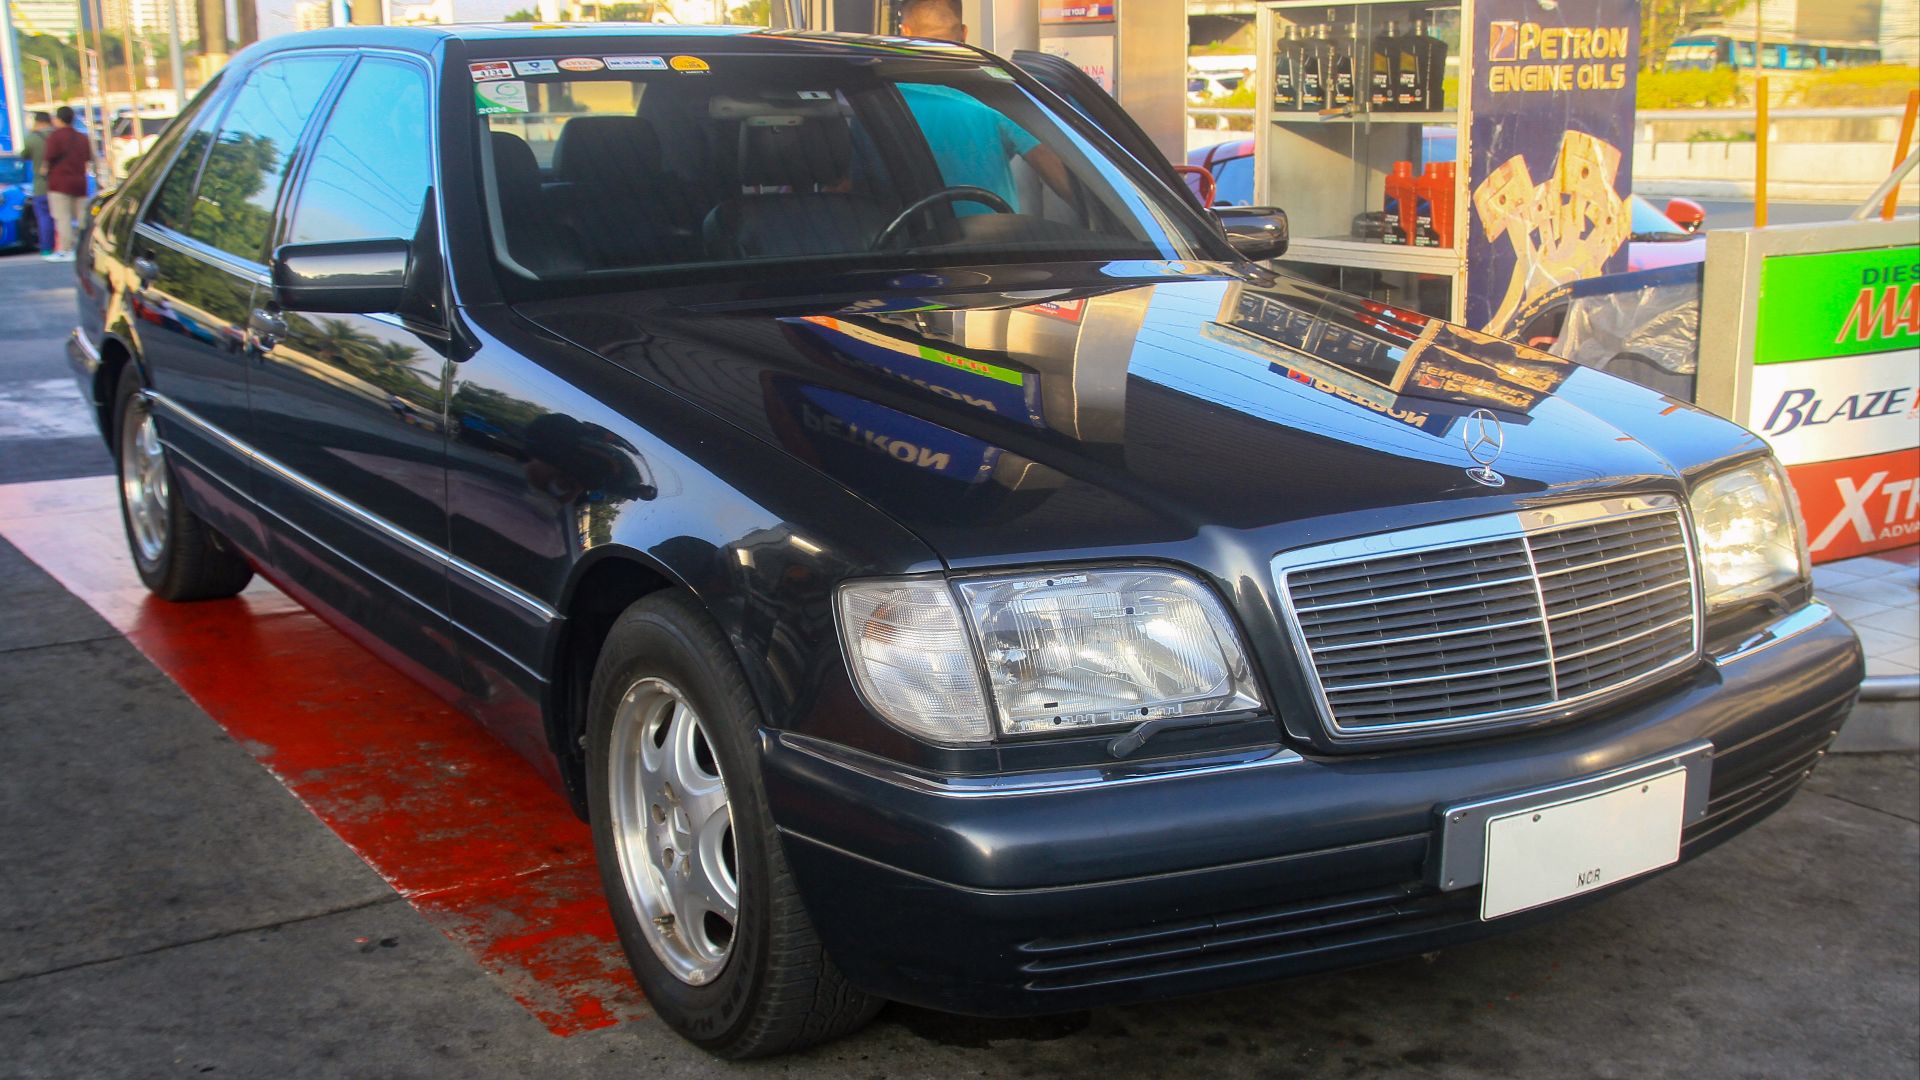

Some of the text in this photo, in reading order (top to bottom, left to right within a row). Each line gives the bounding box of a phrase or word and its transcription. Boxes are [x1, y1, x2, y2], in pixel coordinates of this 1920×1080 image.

[1520, 23, 1629, 60] PETRON
[1489, 63, 1627, 93] ENGINE OILS
[1763, 386, 1912, 437] BLAZE
[1576, 869, 1601, 887] NCR
